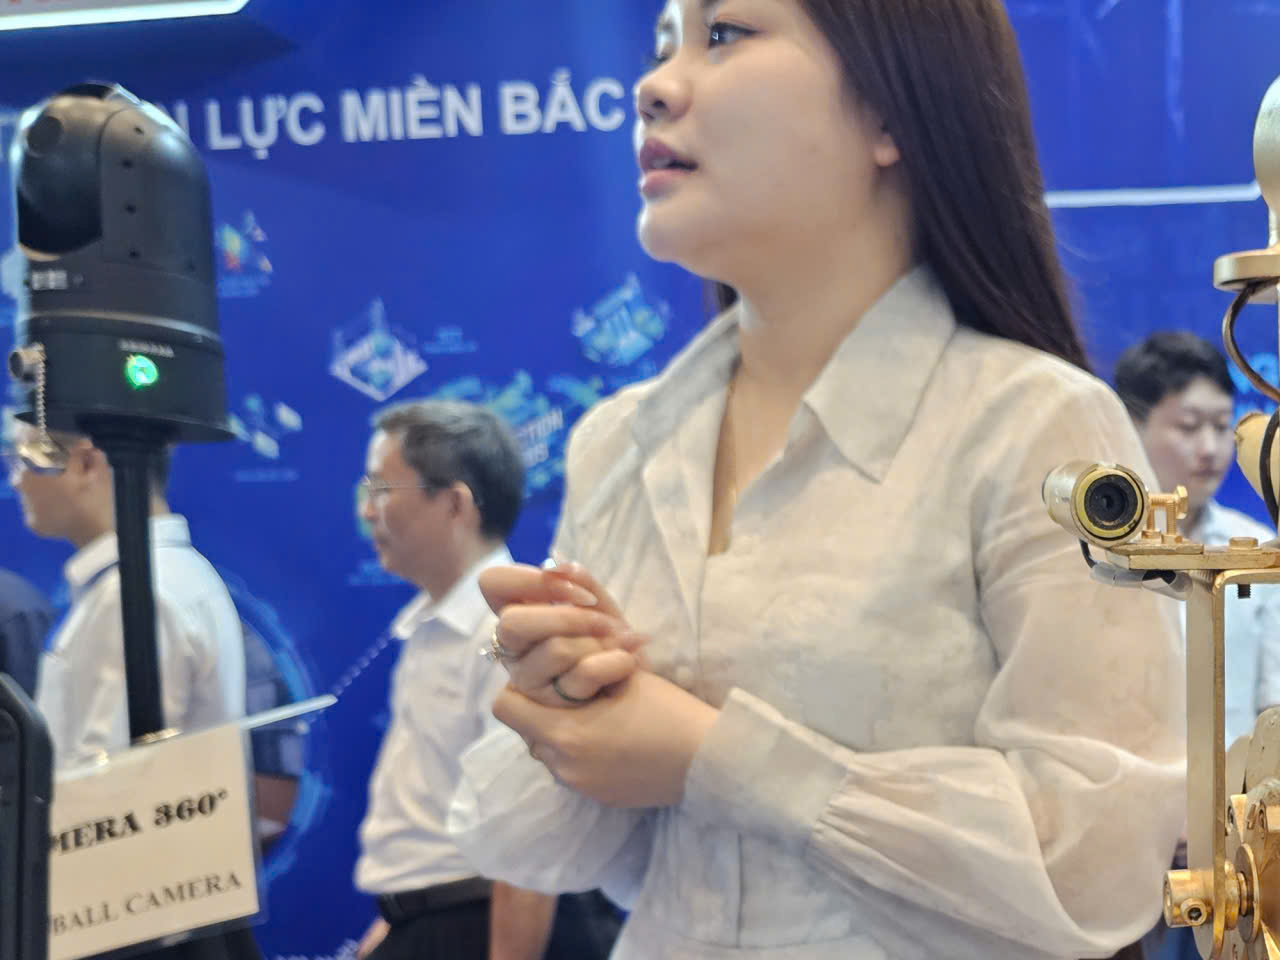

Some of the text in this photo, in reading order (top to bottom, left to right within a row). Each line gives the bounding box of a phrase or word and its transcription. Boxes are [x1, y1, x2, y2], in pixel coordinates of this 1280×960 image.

[206, 90, 327, 160] LỰC
[339, 73, 484, 144] MIỀN
[500, 67, 626, 135] BẮC
[125, 872, 242, 914] CAMERA
